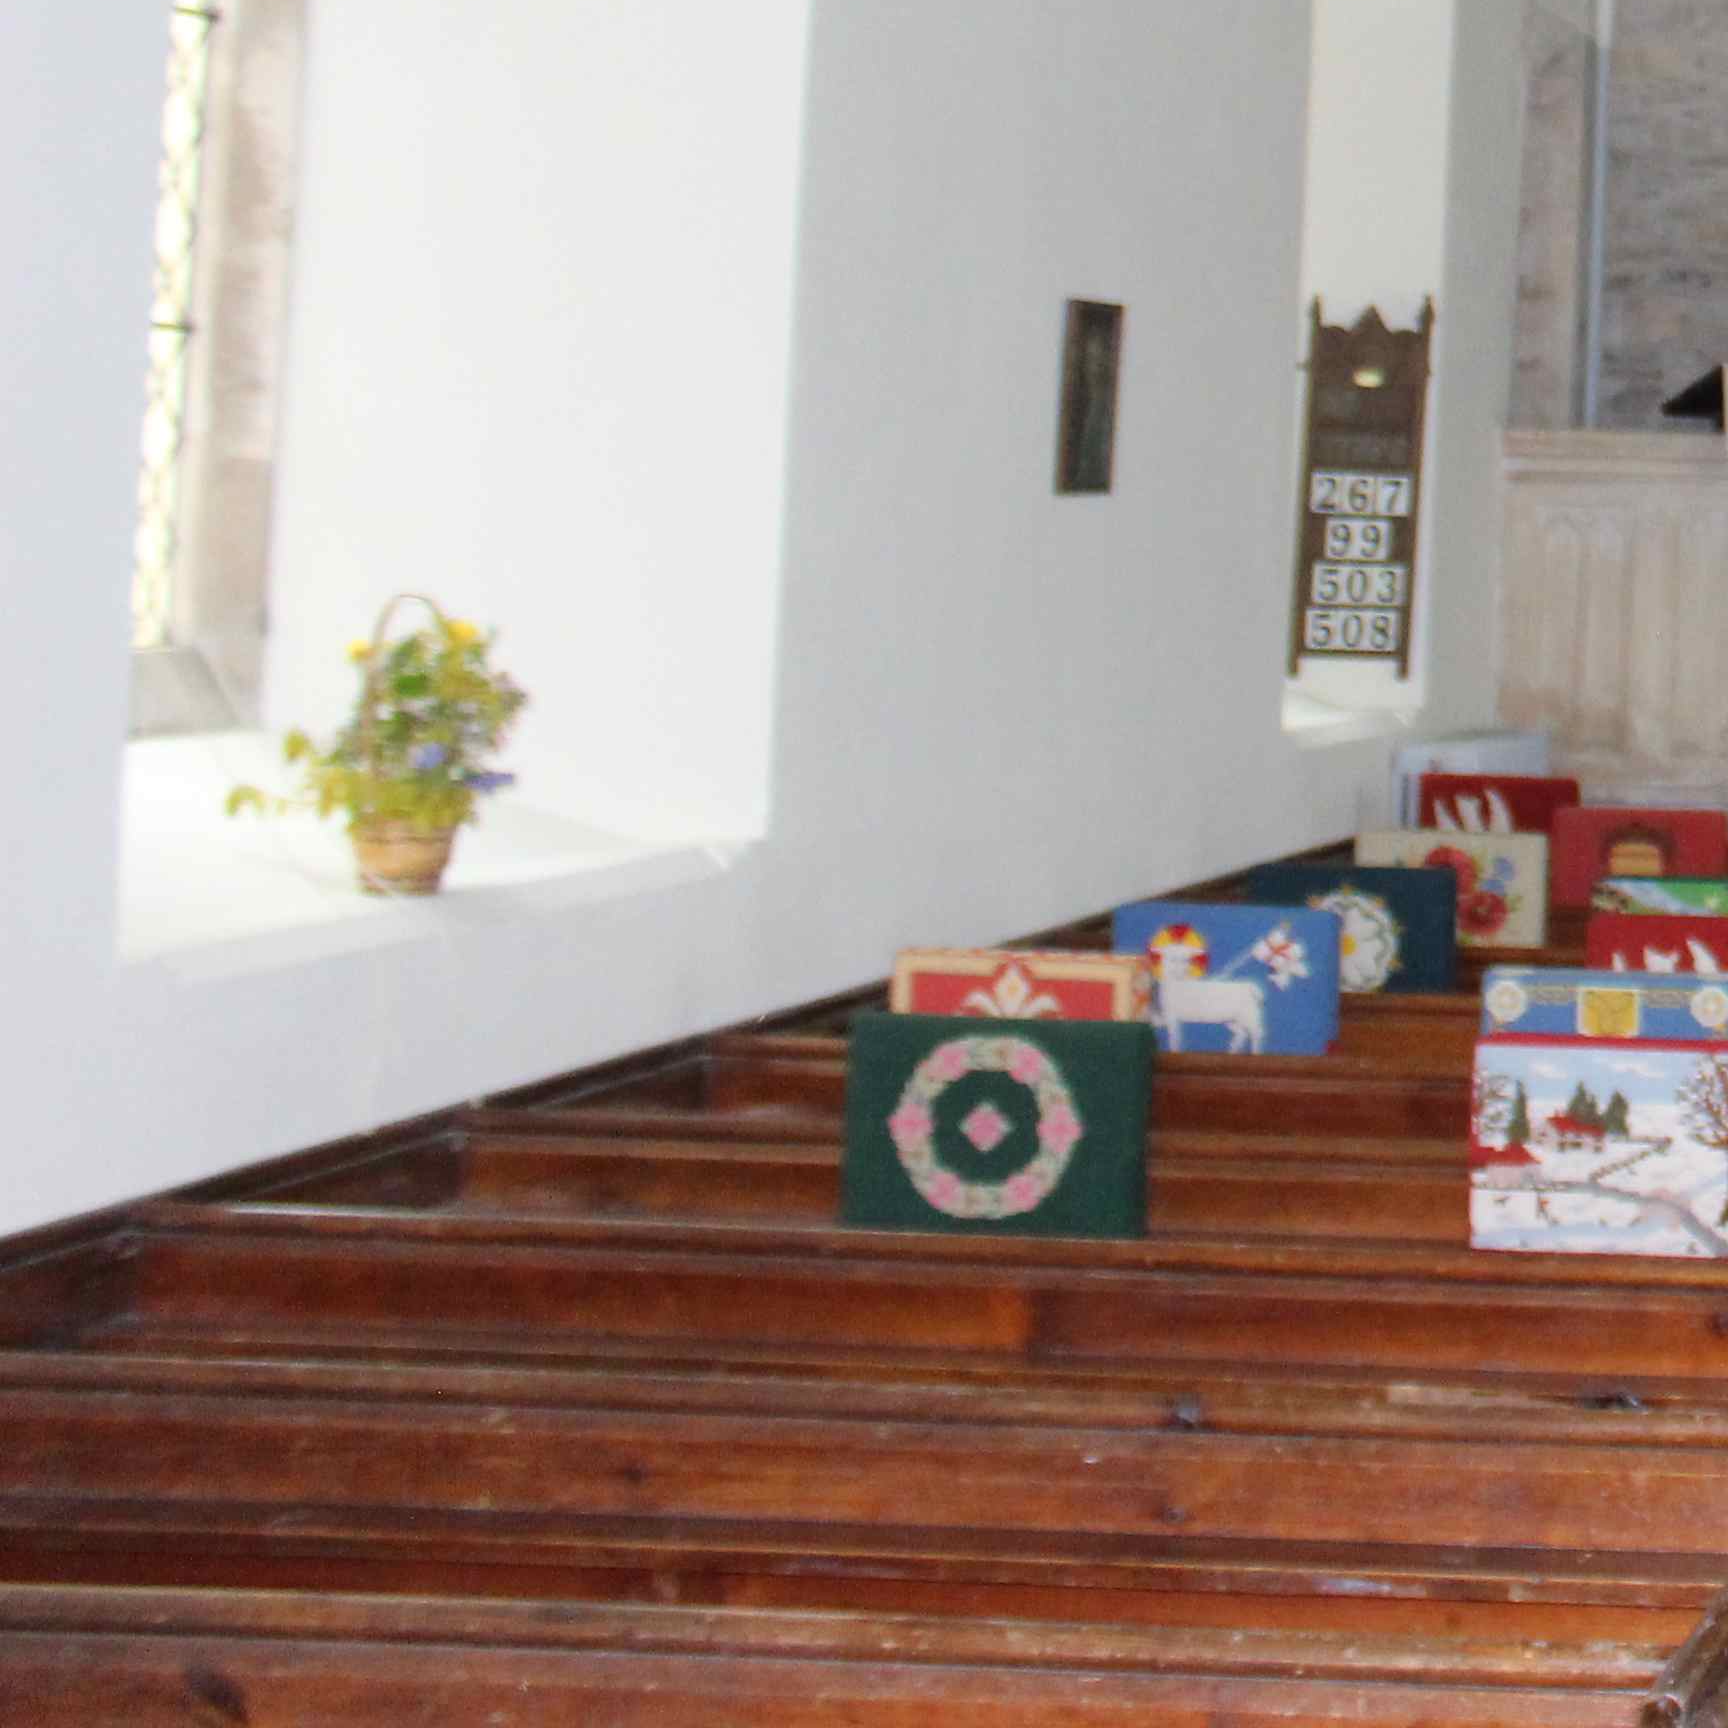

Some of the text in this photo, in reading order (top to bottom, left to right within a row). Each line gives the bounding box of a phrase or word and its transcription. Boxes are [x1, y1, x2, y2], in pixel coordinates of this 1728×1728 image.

[1316, 478, 1402, 512] 267
[1330, 523, 1380, 558] 99
[1317, 568, 1396, 603] 503
[1310, 613, 1391, 649] 508
